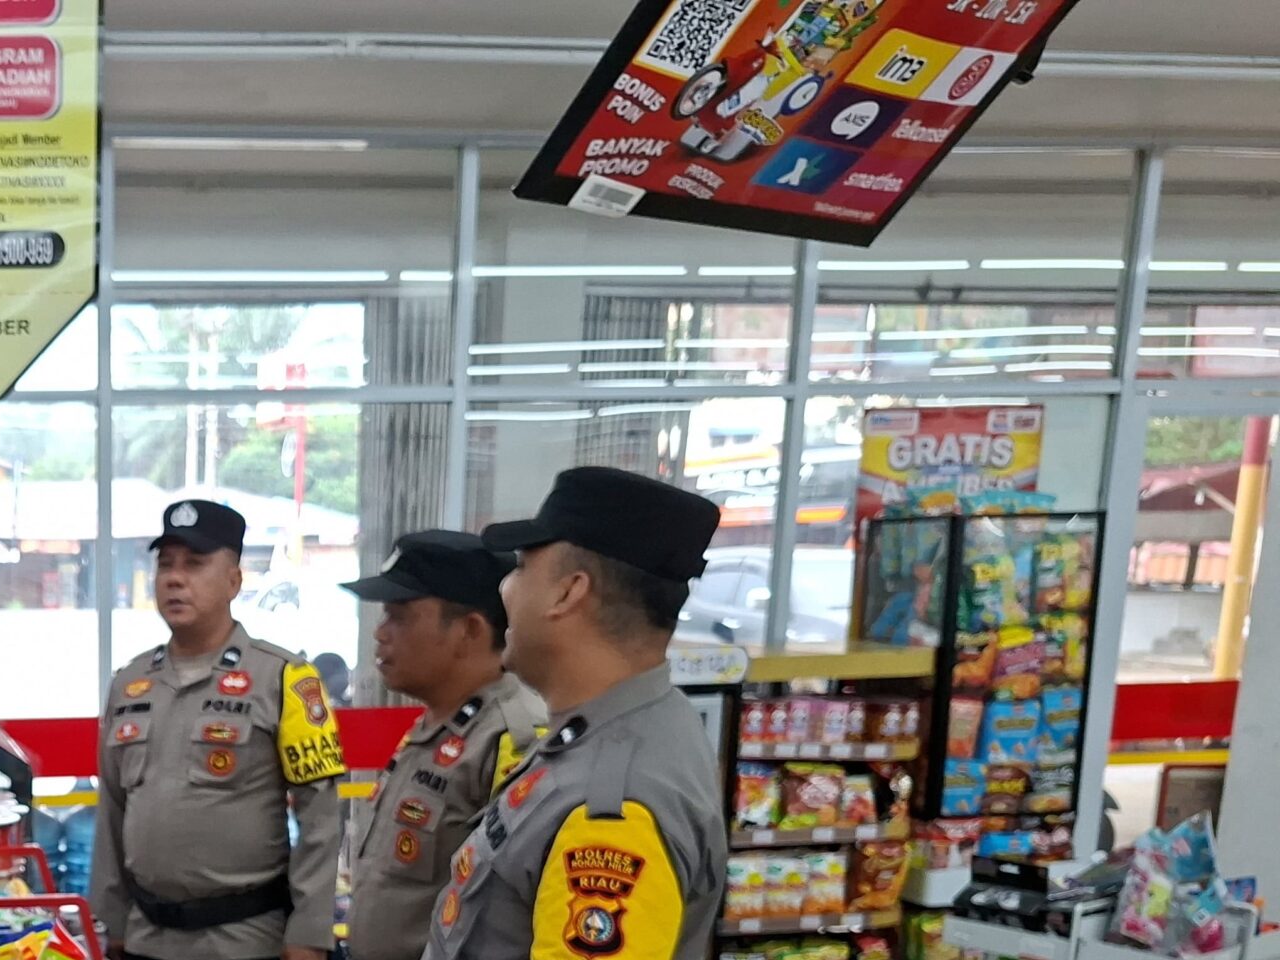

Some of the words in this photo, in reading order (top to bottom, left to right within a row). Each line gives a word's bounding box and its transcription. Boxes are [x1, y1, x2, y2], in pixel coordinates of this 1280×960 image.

[614, 73, 666, 112] BONUS
[607, 95, 644, 124] POIN
[585, 137, 671, 157] BANYAK
[578, 157, 649, 176] PROMO
[888, 434, 1014, 471] GRATIS
[575, 849, 632, 866] POLRES
[579, 876, 620, 890] RIAU
